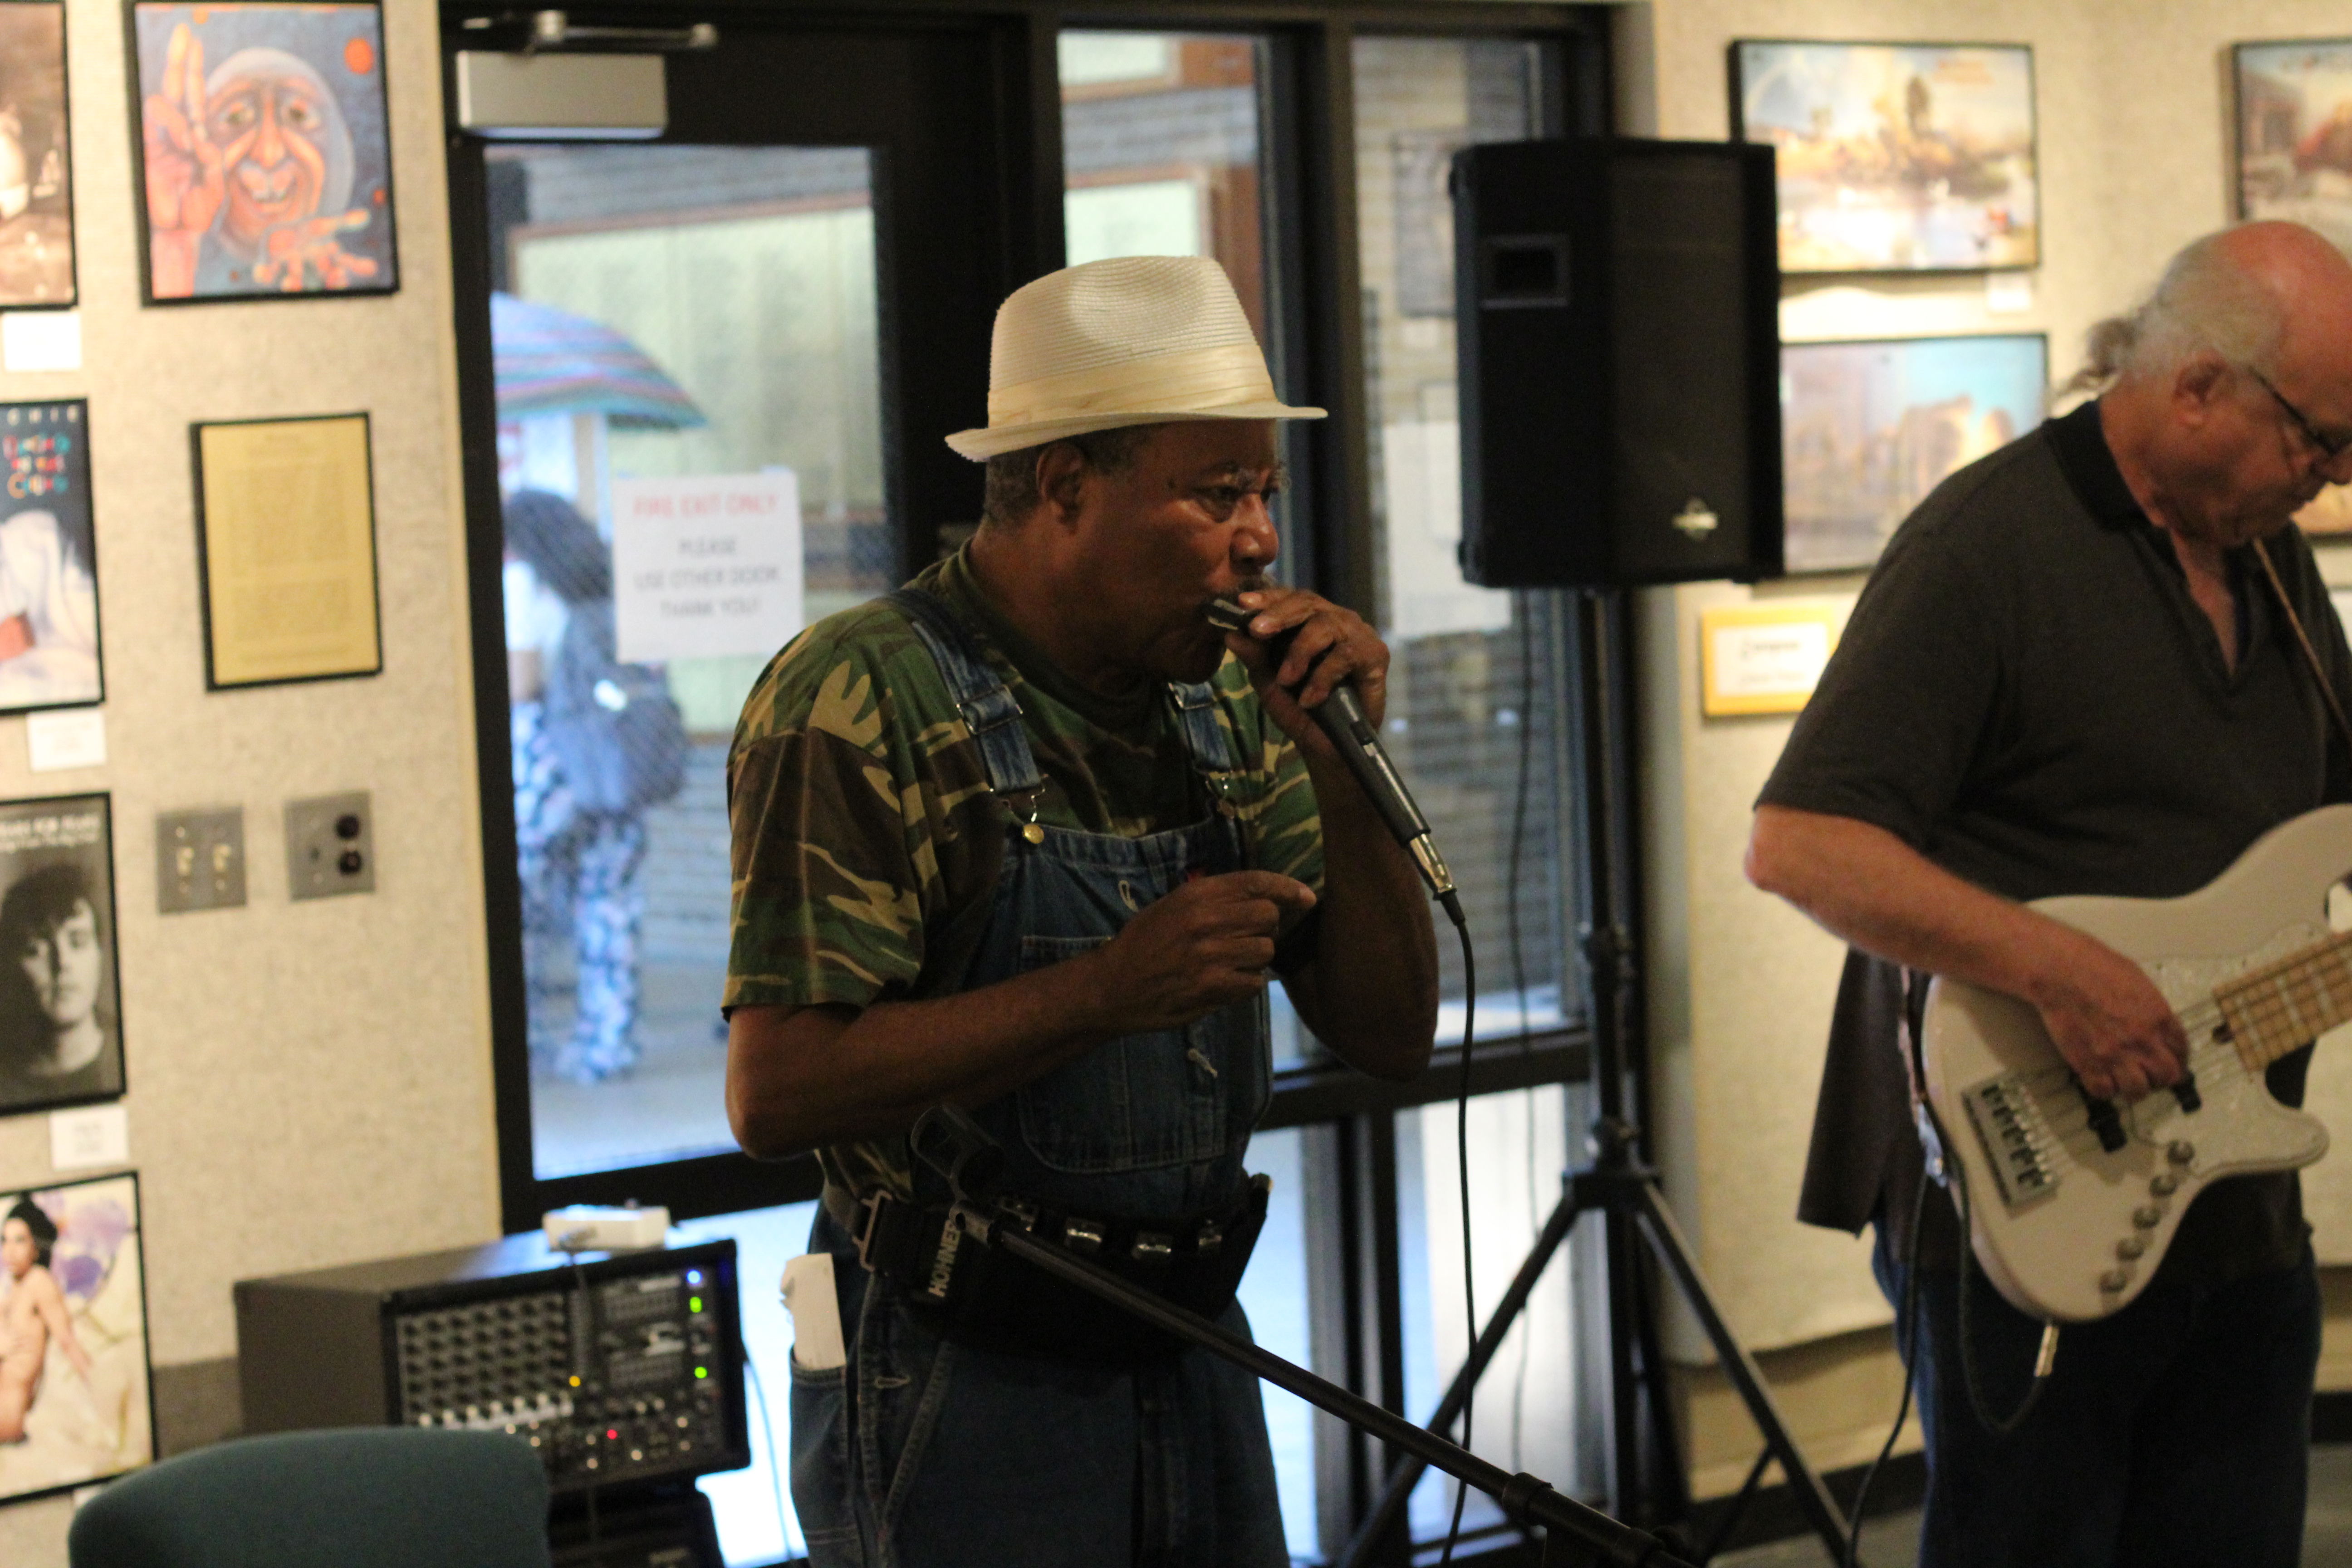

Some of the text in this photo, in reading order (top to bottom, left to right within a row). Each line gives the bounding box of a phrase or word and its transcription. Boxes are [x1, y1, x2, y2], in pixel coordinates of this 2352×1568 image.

[633, 493, 777, 519] FIRE EXIT ONLY
[678, 535, 738, 557] PLEASE
[634, 571, 665, 590] USE
[670, 567, 725, 589] OTHER
[661, 599, 715, 618] THANK
